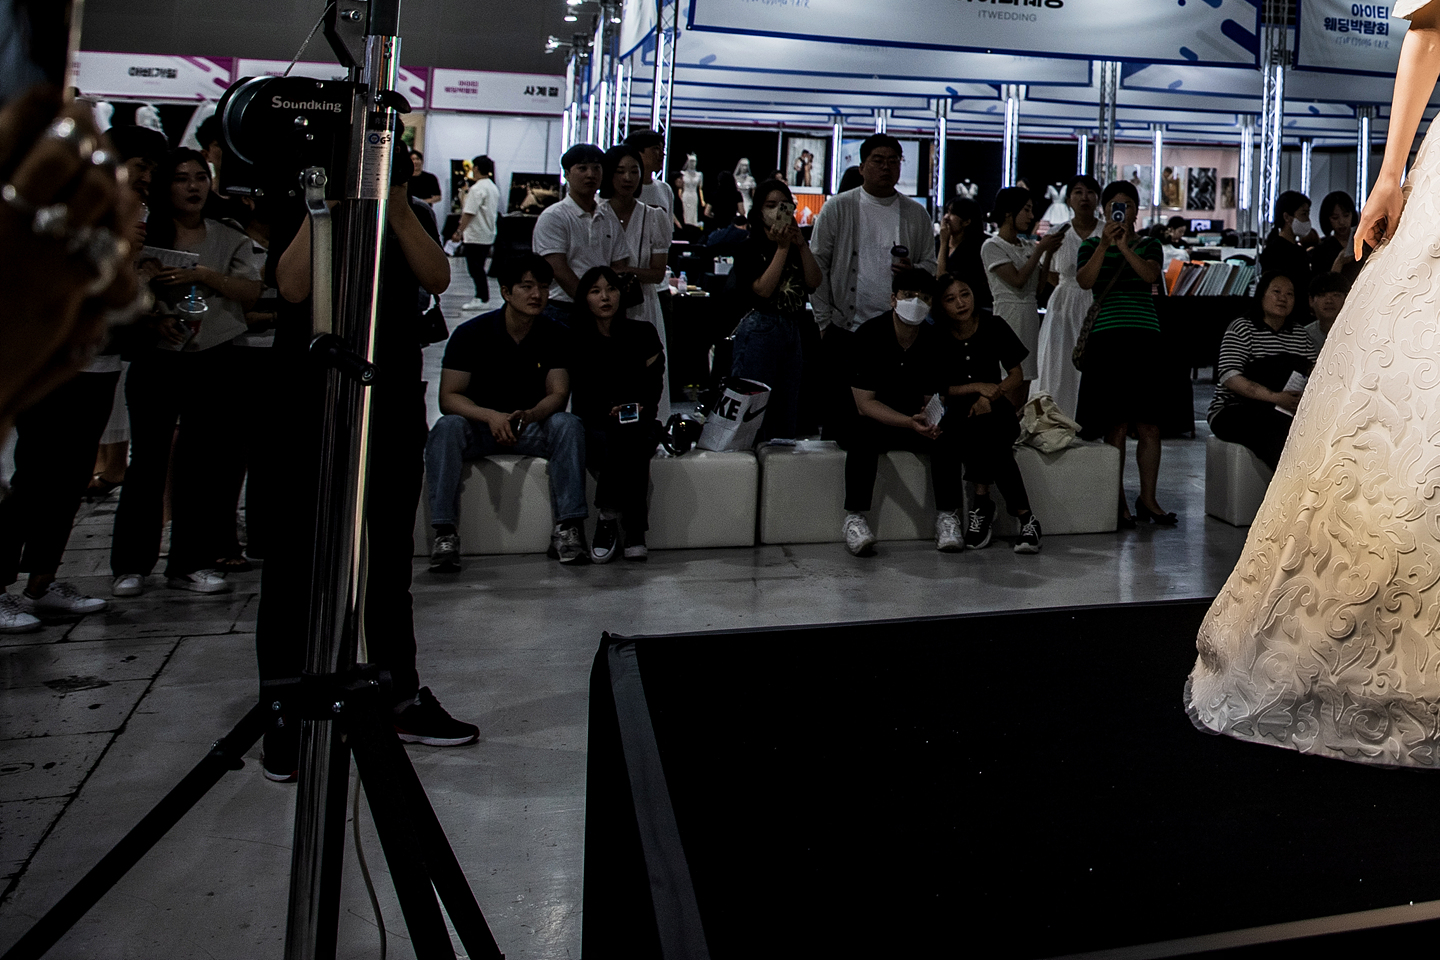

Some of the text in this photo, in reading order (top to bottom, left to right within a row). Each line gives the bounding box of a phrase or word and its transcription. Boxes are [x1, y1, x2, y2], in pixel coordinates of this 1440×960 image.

[977, 9, 1037, 23] ITWEDDING
[1351, 3, 1389, 20] 아이티
[1323, 17, 1389, 37] 웨딩박람회
